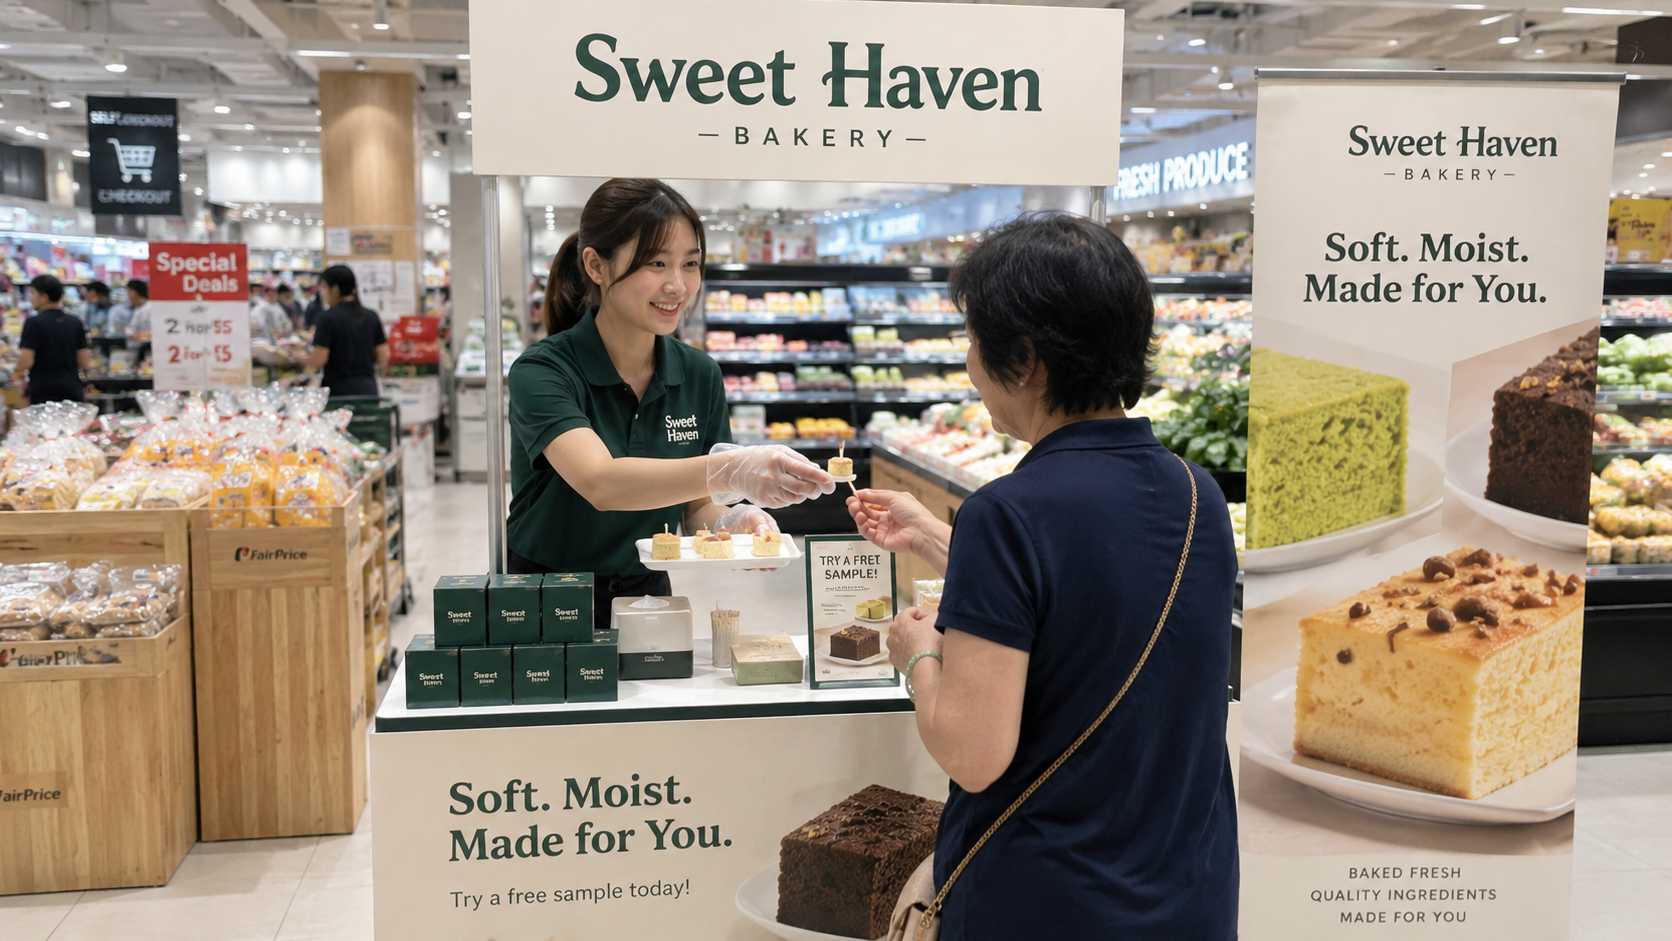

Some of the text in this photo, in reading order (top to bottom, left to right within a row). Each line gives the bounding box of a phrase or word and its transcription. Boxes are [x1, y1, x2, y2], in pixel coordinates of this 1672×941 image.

[574, 32, 1043, 112] Sweet Haven
[735, 126, 893, 149] BAKERY
[1348, 124, 1558, 157] Sweet Haven
[1113, 141, 1249, 201] FRESH PRODUCE
[1404, 168, 1498, 181] BAKERY
[1324, 231, 1529, 263] Soft. Moist.
[156, 251, 237, 276] Special
[182, 274, 239, 293] Deals
[1303, 272, 1548, 304] Made for You.
[168, 345, 181, 363] 2
[665, 414, 698, 429] Sweet
[667, 428, 699, 442] Haven
[250, 548, 308, 561] FairPrice
[819, 555, 841, 566] TRY
[843, 555, 851, 566] A
[825, 568, 878, 580] SAMPLE!
[449, 773, 692, 816] Soft. Moist.
[448, 818, 734, 862] Made for You.
[1349, 866, 1462, 879] BAKED FRESH
[449, 878, 691, 911] Try a free sample today!
[1310, 888, 1498, 903] QUALITY INGREDIENTS
[1340, 911, 1467, 923] MADE FOR YOU
